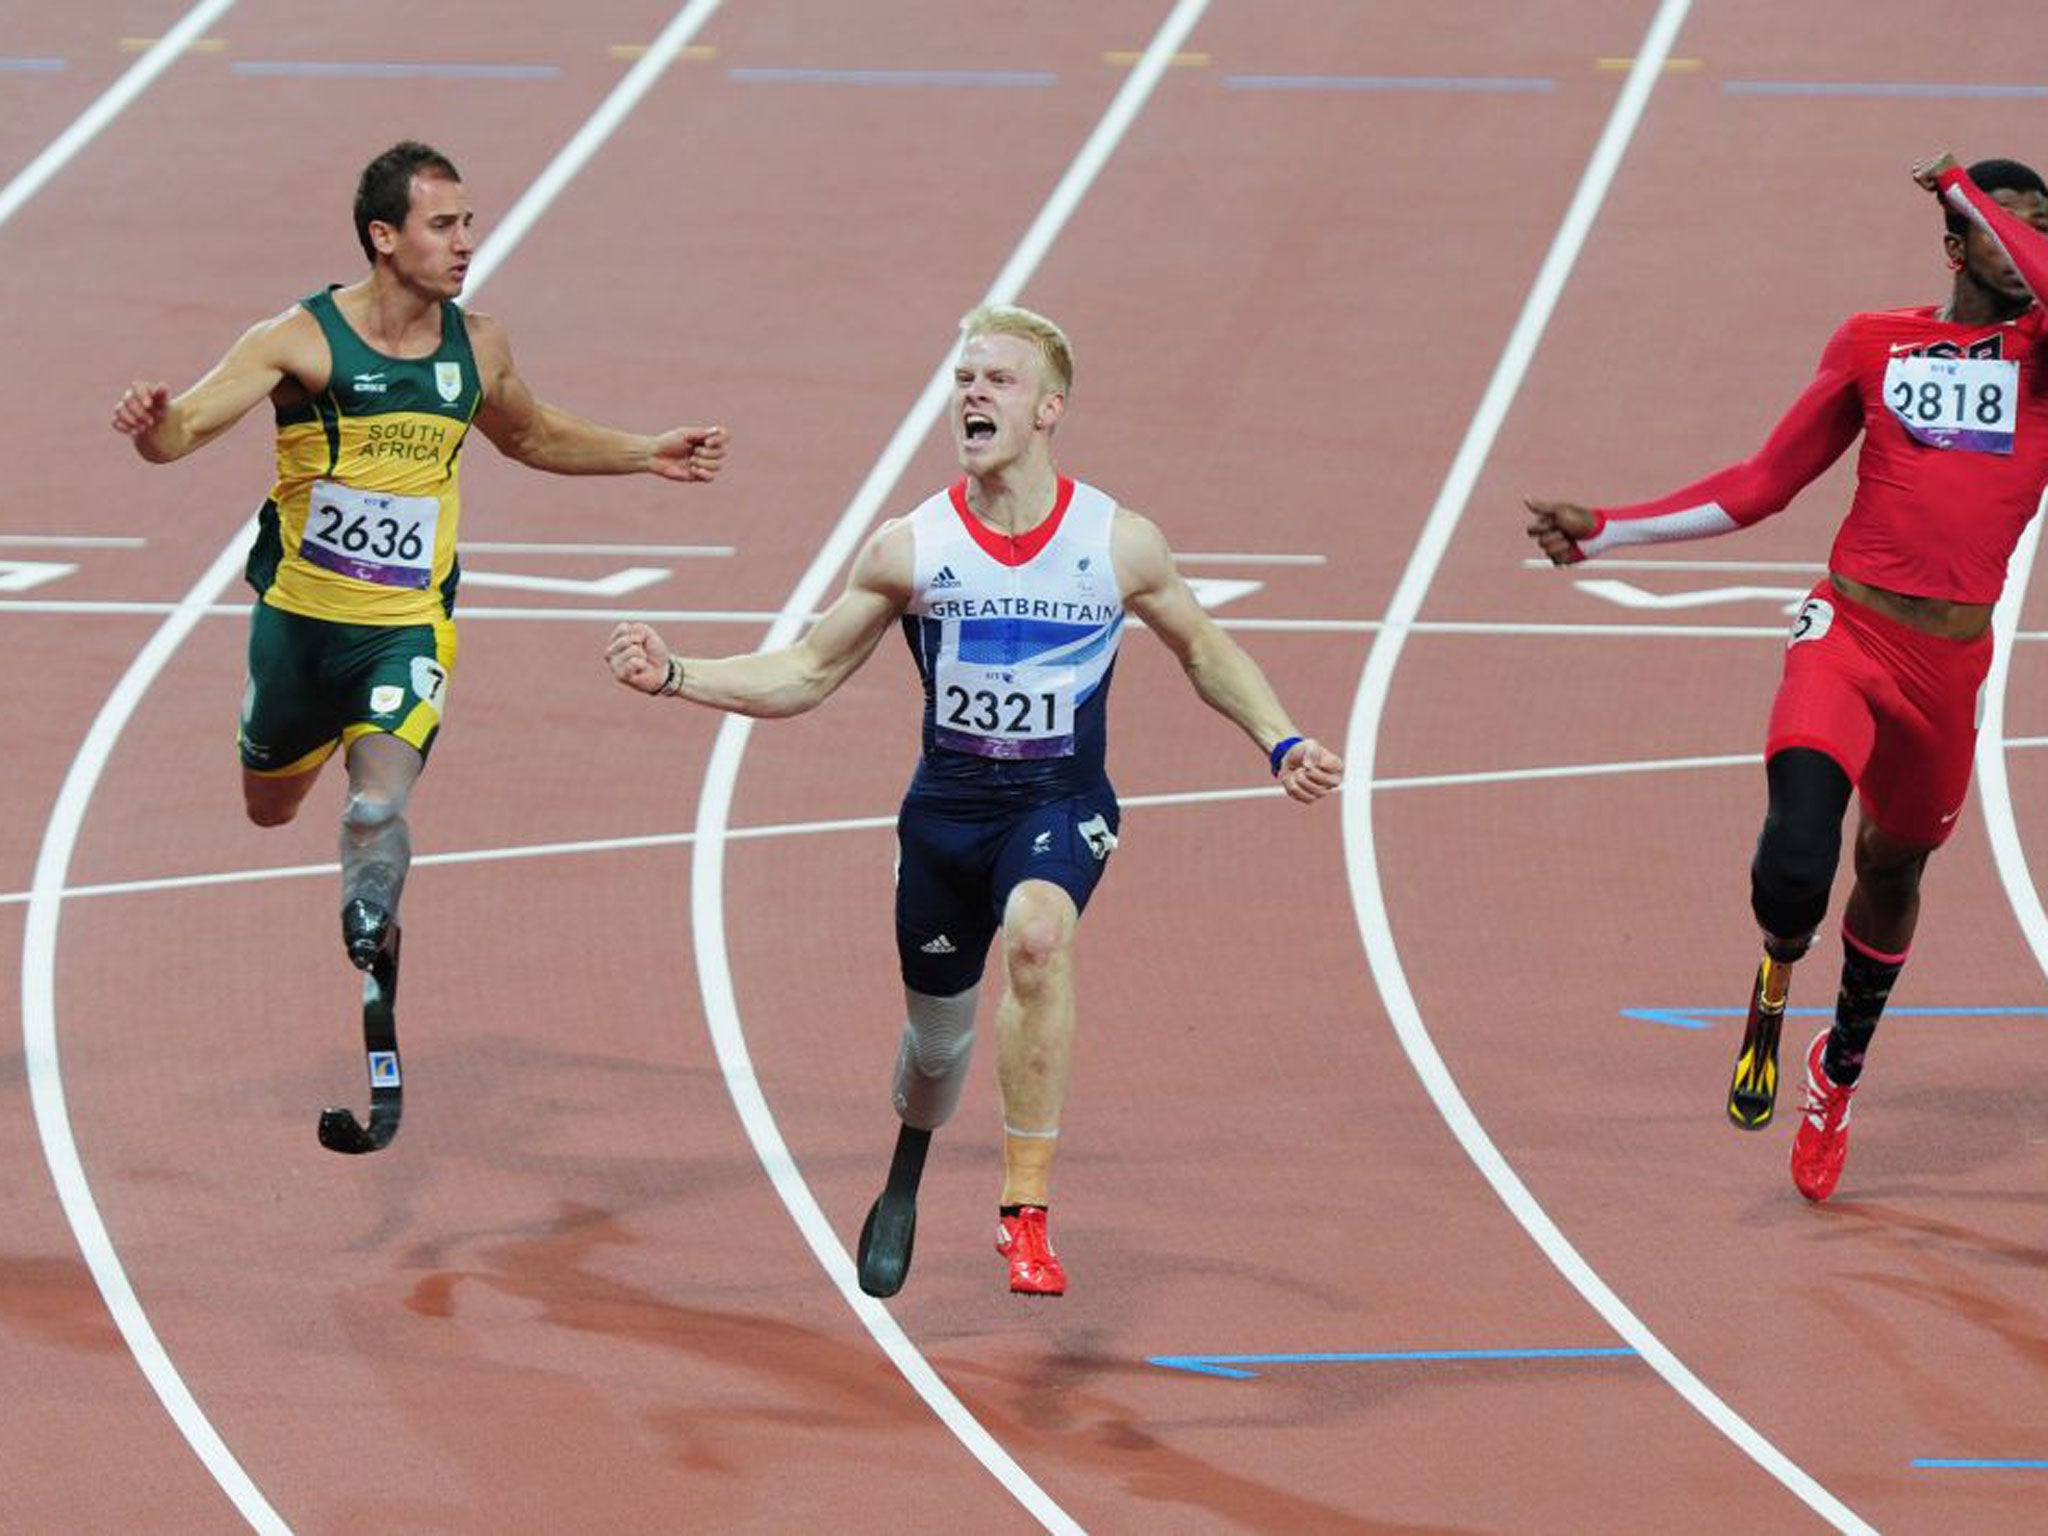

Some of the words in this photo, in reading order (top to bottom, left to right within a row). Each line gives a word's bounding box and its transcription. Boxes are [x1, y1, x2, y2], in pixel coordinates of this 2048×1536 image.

[1893, 381, 2002, 424] 2818
[358, 440, 439, 461] AFRICA
[368, 424, 445, 443] SOUTH
[317, 505, 423, 560] 2636
[426, 666, 444, 699] 7
[946, 685, 1056, 733] 2321
